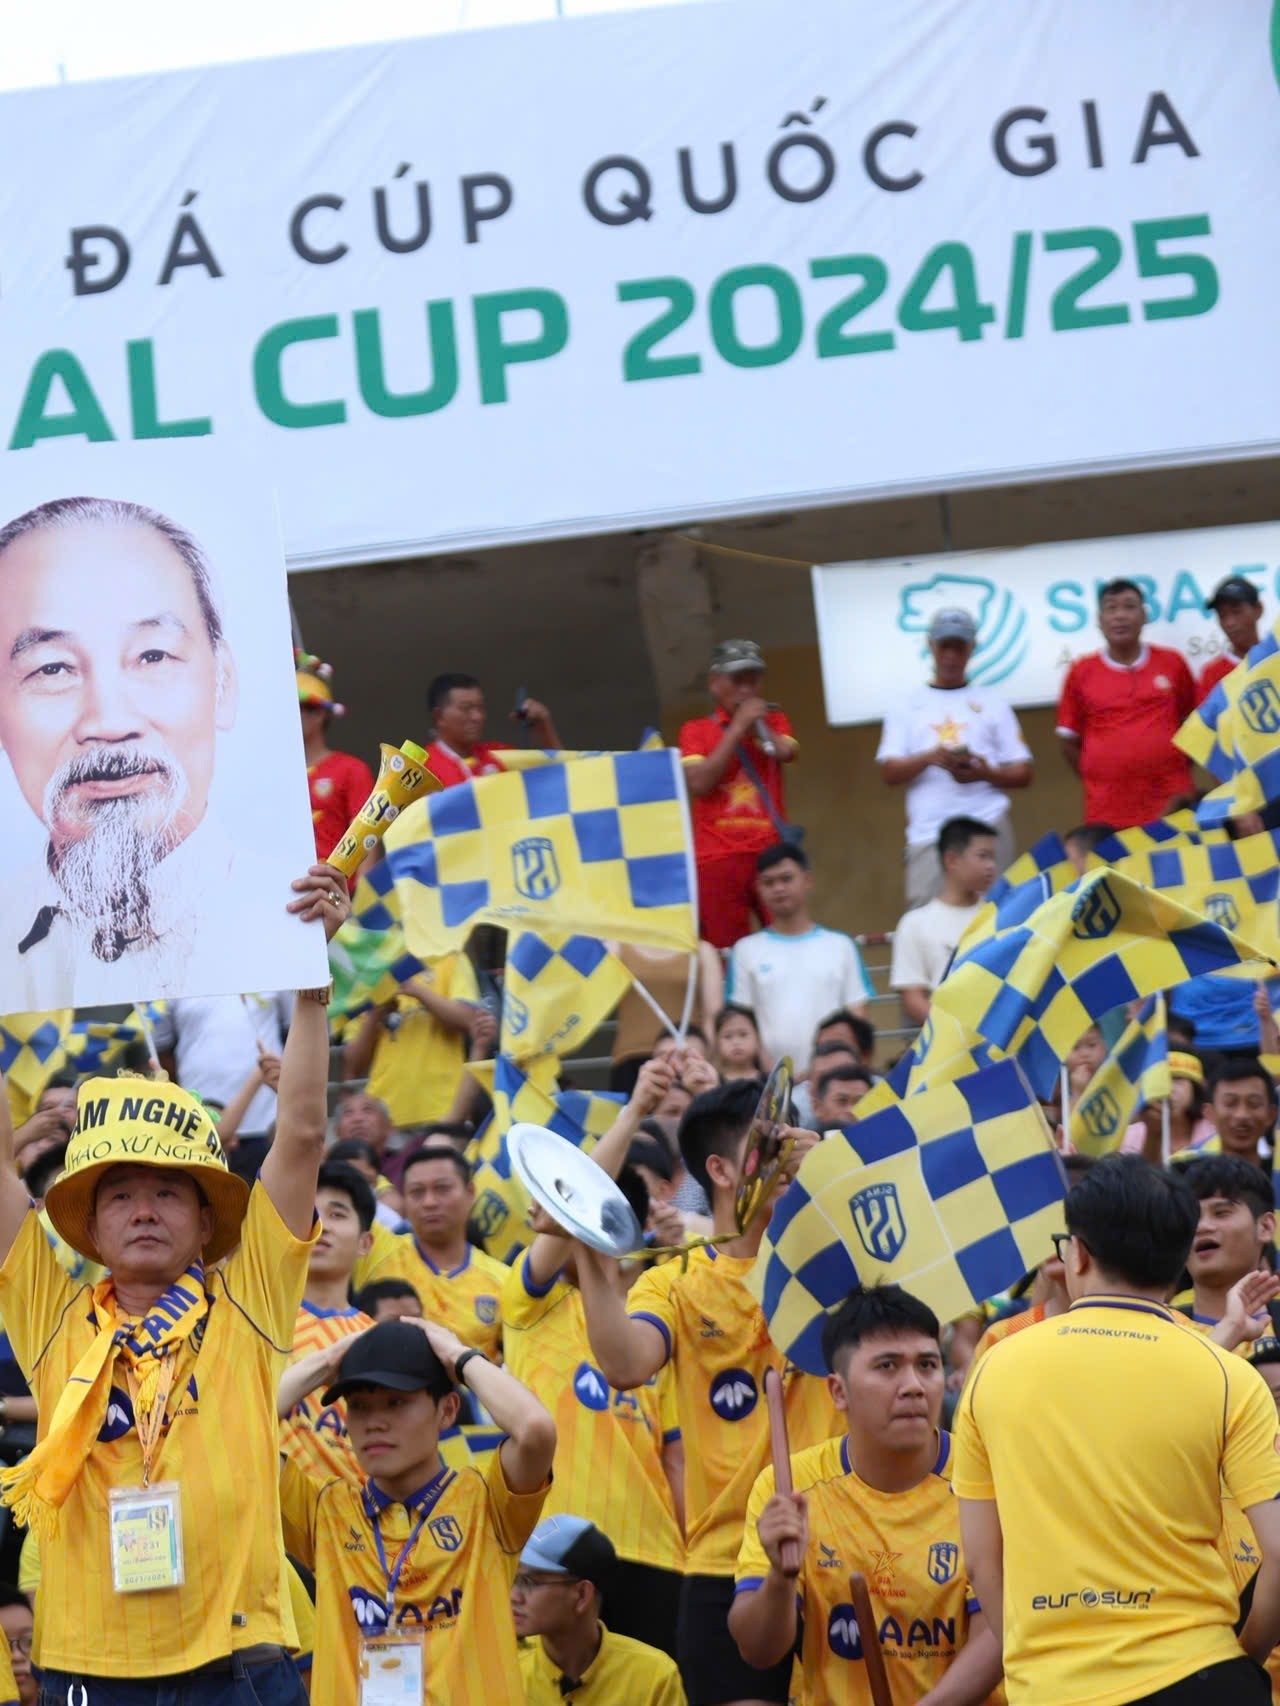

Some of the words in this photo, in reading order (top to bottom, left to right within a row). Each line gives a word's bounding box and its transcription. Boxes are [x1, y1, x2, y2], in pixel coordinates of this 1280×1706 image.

[64, 190, 224, 298] ĐÁ
[288, 162, 514, 266] CÚP
[582, 97, 925, 227] QUỐC
[992, 91, 1202, 178] GIA
[252, 286, 570, 430] CUP
[617, 214, 1221, 383] 2024/25
[1070, 1326, 1160, 1342] NIKKOKUTRUST
[879, 1615, 956, 1648] AAN
